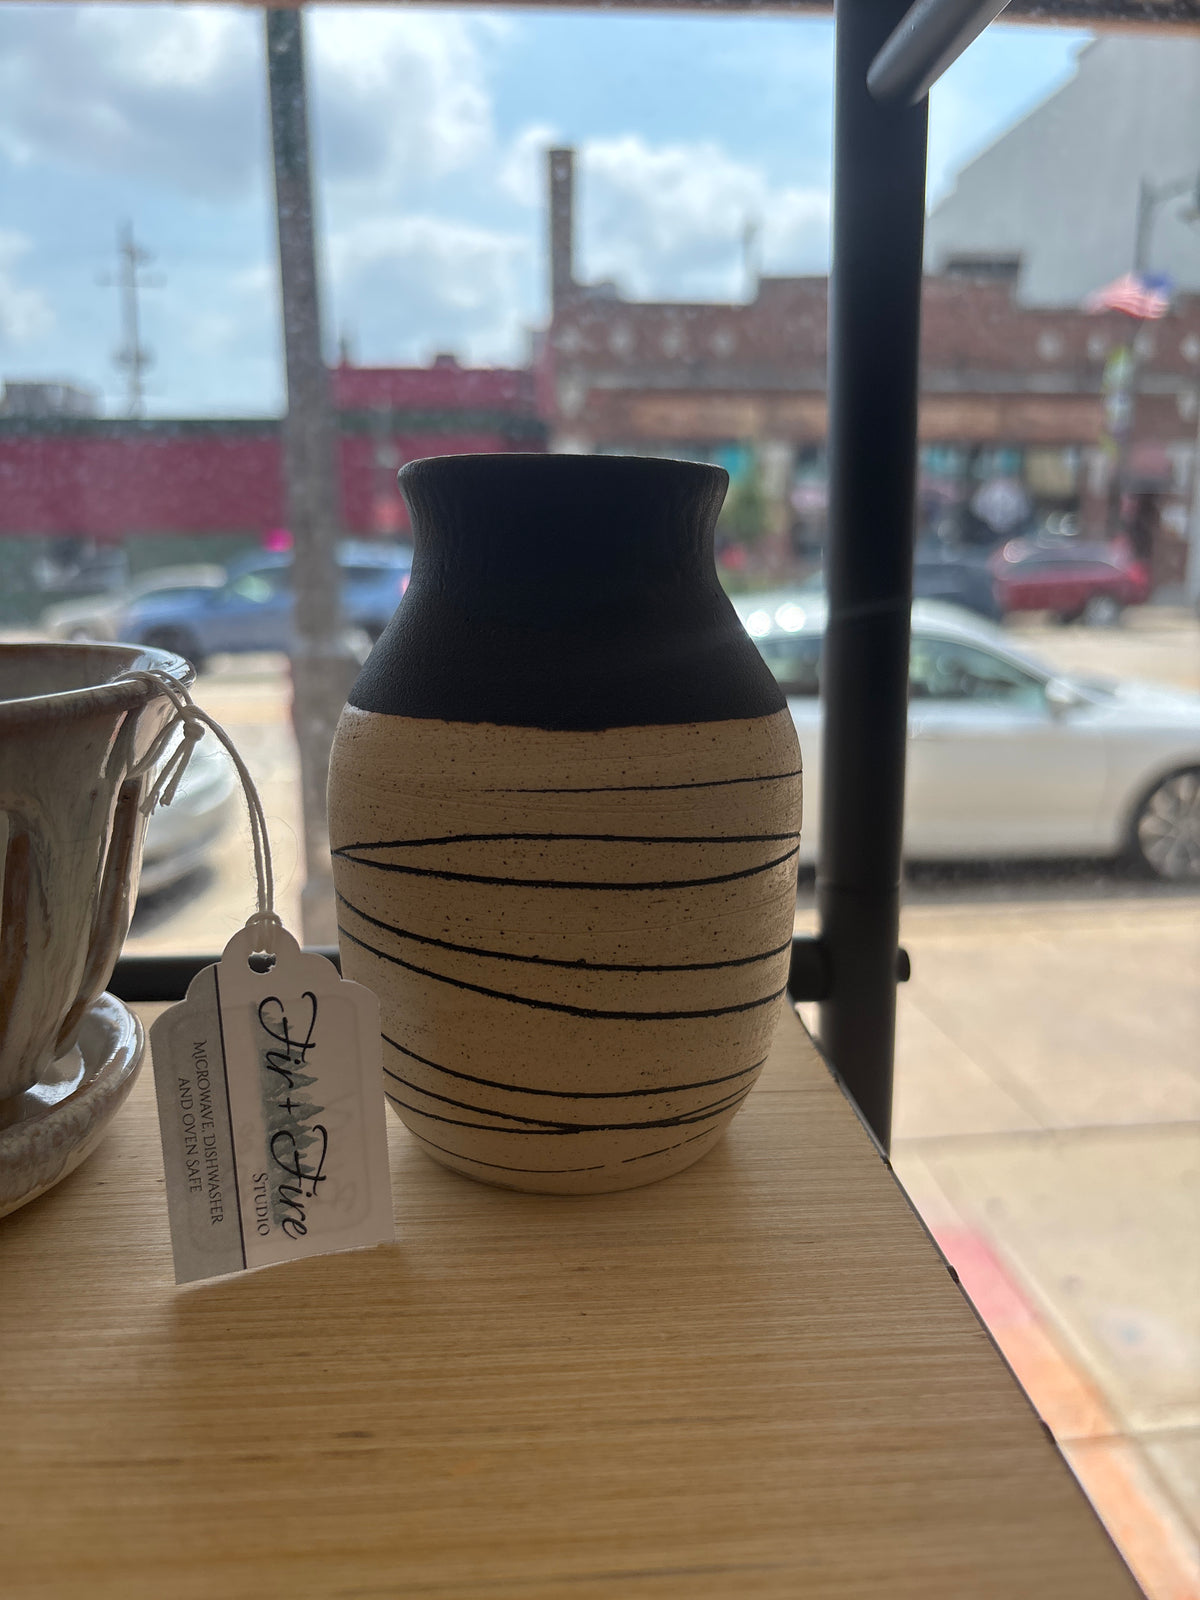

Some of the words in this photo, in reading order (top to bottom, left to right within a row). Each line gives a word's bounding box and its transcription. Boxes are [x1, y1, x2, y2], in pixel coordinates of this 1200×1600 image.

[258, 991, 318, 1089] Fir
[279, 1097, 300, 1118] +
[269, 1124, 328, 1240] Fire
